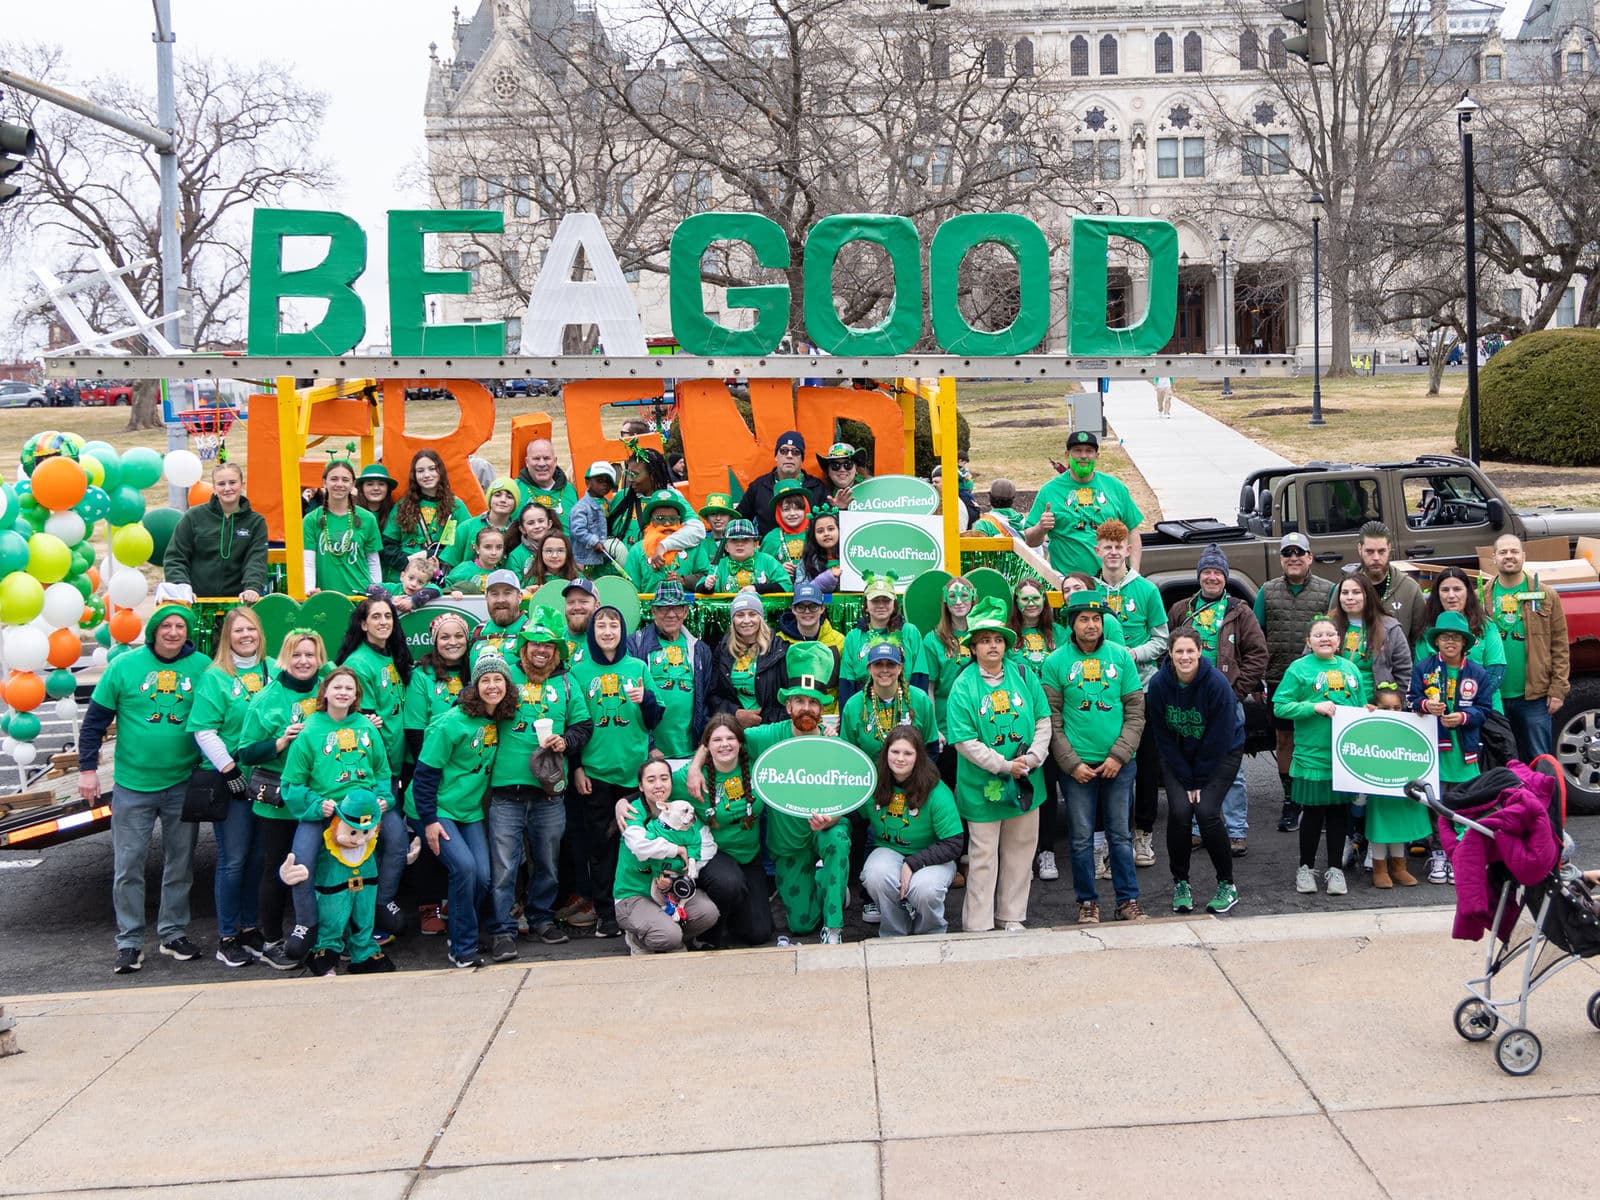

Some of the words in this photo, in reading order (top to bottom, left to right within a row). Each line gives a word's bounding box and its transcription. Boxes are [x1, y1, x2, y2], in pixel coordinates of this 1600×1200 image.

[248, 208, 505, 356] BE
[520, 212, 648, 356] A
[669, 212, 1178, 356] GOOD
[850, 496, 935, 511] BeAGoodFriend
[849, 546, 936, 560] #BeAGoodFriend
[1342, 742, 1430, 762] #BeAGoodFriend
[758, 768, 871, 786] #BeAGoodFriend
